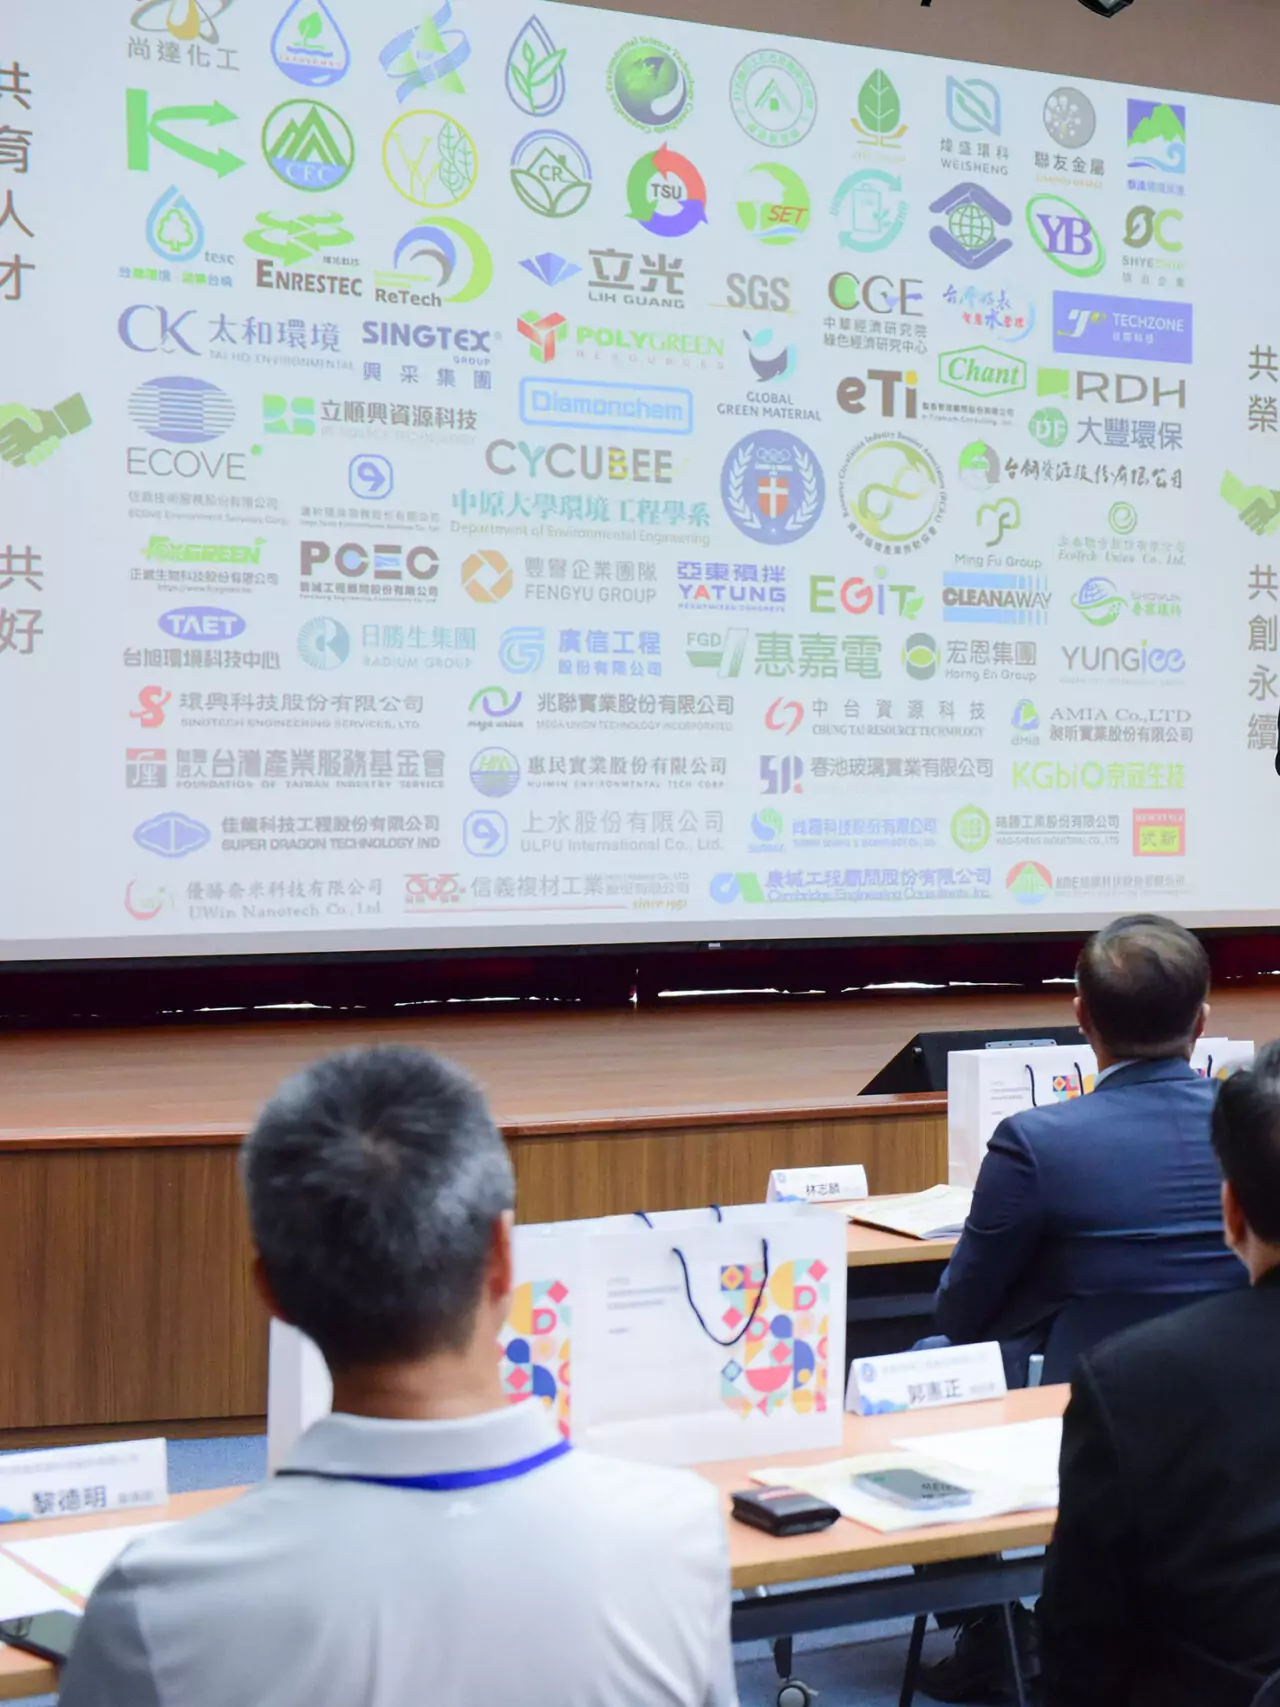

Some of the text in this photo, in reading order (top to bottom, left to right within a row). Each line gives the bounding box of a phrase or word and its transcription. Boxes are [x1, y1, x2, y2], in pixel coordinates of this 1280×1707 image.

[940, 157, 1009, 176] WEISHENG
[1033, 150, 1105, 177] 聯友金屬
[651, 183, 682, 201] TSU
[768, 204, 808, 224] SET
[1036, 213, 1093, 256] YB
[256, 258, 362, 297] ENRESTEC
[588, 248, 686, 296] 立光
[375, 288, 442, 308] ReTech
[623, 294, 686, 309] GUANG
[726, 272, 791, 311] SGS
[117, 304, 202, 357] CK
[208, 313, 342, 353] 太和環境
[1112, 312, 1184, 332] TECHZONE
[362, 321, 491, 353] SINGTEX
[576, 326, 725, 356] POLYGREEN
[453, 355, 490, 367] GROUP
[949, 357, 1020, 385] Chant
[363, 361, 492, 390] 興采集團
[746, 391, 794, 406] GLOBAL
[1076, 370, 1186, 409] RDH
[1247, 344, 1278, 433] 共榮
[320, 400, 478, 431] 立順興資源科技
[531, 390, 683, 421] Diamonchem
[716, 402, 823, 422] GREEN MATERIAL
[1076, 415, 1184, 451] 大豐環保
[126, 446, 247, 481] ECOVE
[485, 438, 673, 484] CYCUBEE
[451, 487, 711, 527] 中原大學環境工程學系
[451, 520, 527, 537] Department
[548, 525, 636, 543] Environmental
[677, 561, 786, 583] 亞東預拌
[954, 553, 984, 568] Ming
[1005, 556, 1043, 570] Group
[524, 584, 657, 604] FENGYU GROUP
[678, 584, 786, 602] YATUNG
[942, 586, 1052, 609] CLEANAWAY
[168, 614, 237, 636] TAET
[361, 624, 477, 651] 日勝生集團
[558, 629, 661, 655] 廣信工程
[687, 633, 722, 648] FGD
[123, 648, 281, 670] 台旭環境科技中心
[754, 631, 882, 680] 惠嘉電
[946, 640, 1037, 666] 宏恩集團
[1247, 564, 1278, 750] 共創永續
[558, 659, 662, 677] 股份有限公司
[1000, 670, 1037, 683] Group
[179, 691, 424, 713] 環興科技股份有限公司
[537, 692, 735, 715] 兆聯實業股份有限公司
[812, 698, 985, 721] 中台資源科技
[1050, 707, 1108, 722] AMIA
[212, 748, 446, 778] 台灣產業服務基金會
[528, 755, 727, 776] 惠民實業股份有限公司
[810, 756, 994, 778] 春池玻璃實業有限公司
[521, 809, 724, 834] 上水股份有限公司
[221, 837, 441, 851] SUPER DRAGON TECHNOLOGY IND
[568, 838, 660, 852] International
[243, 903, 320, 919] Nanotech
